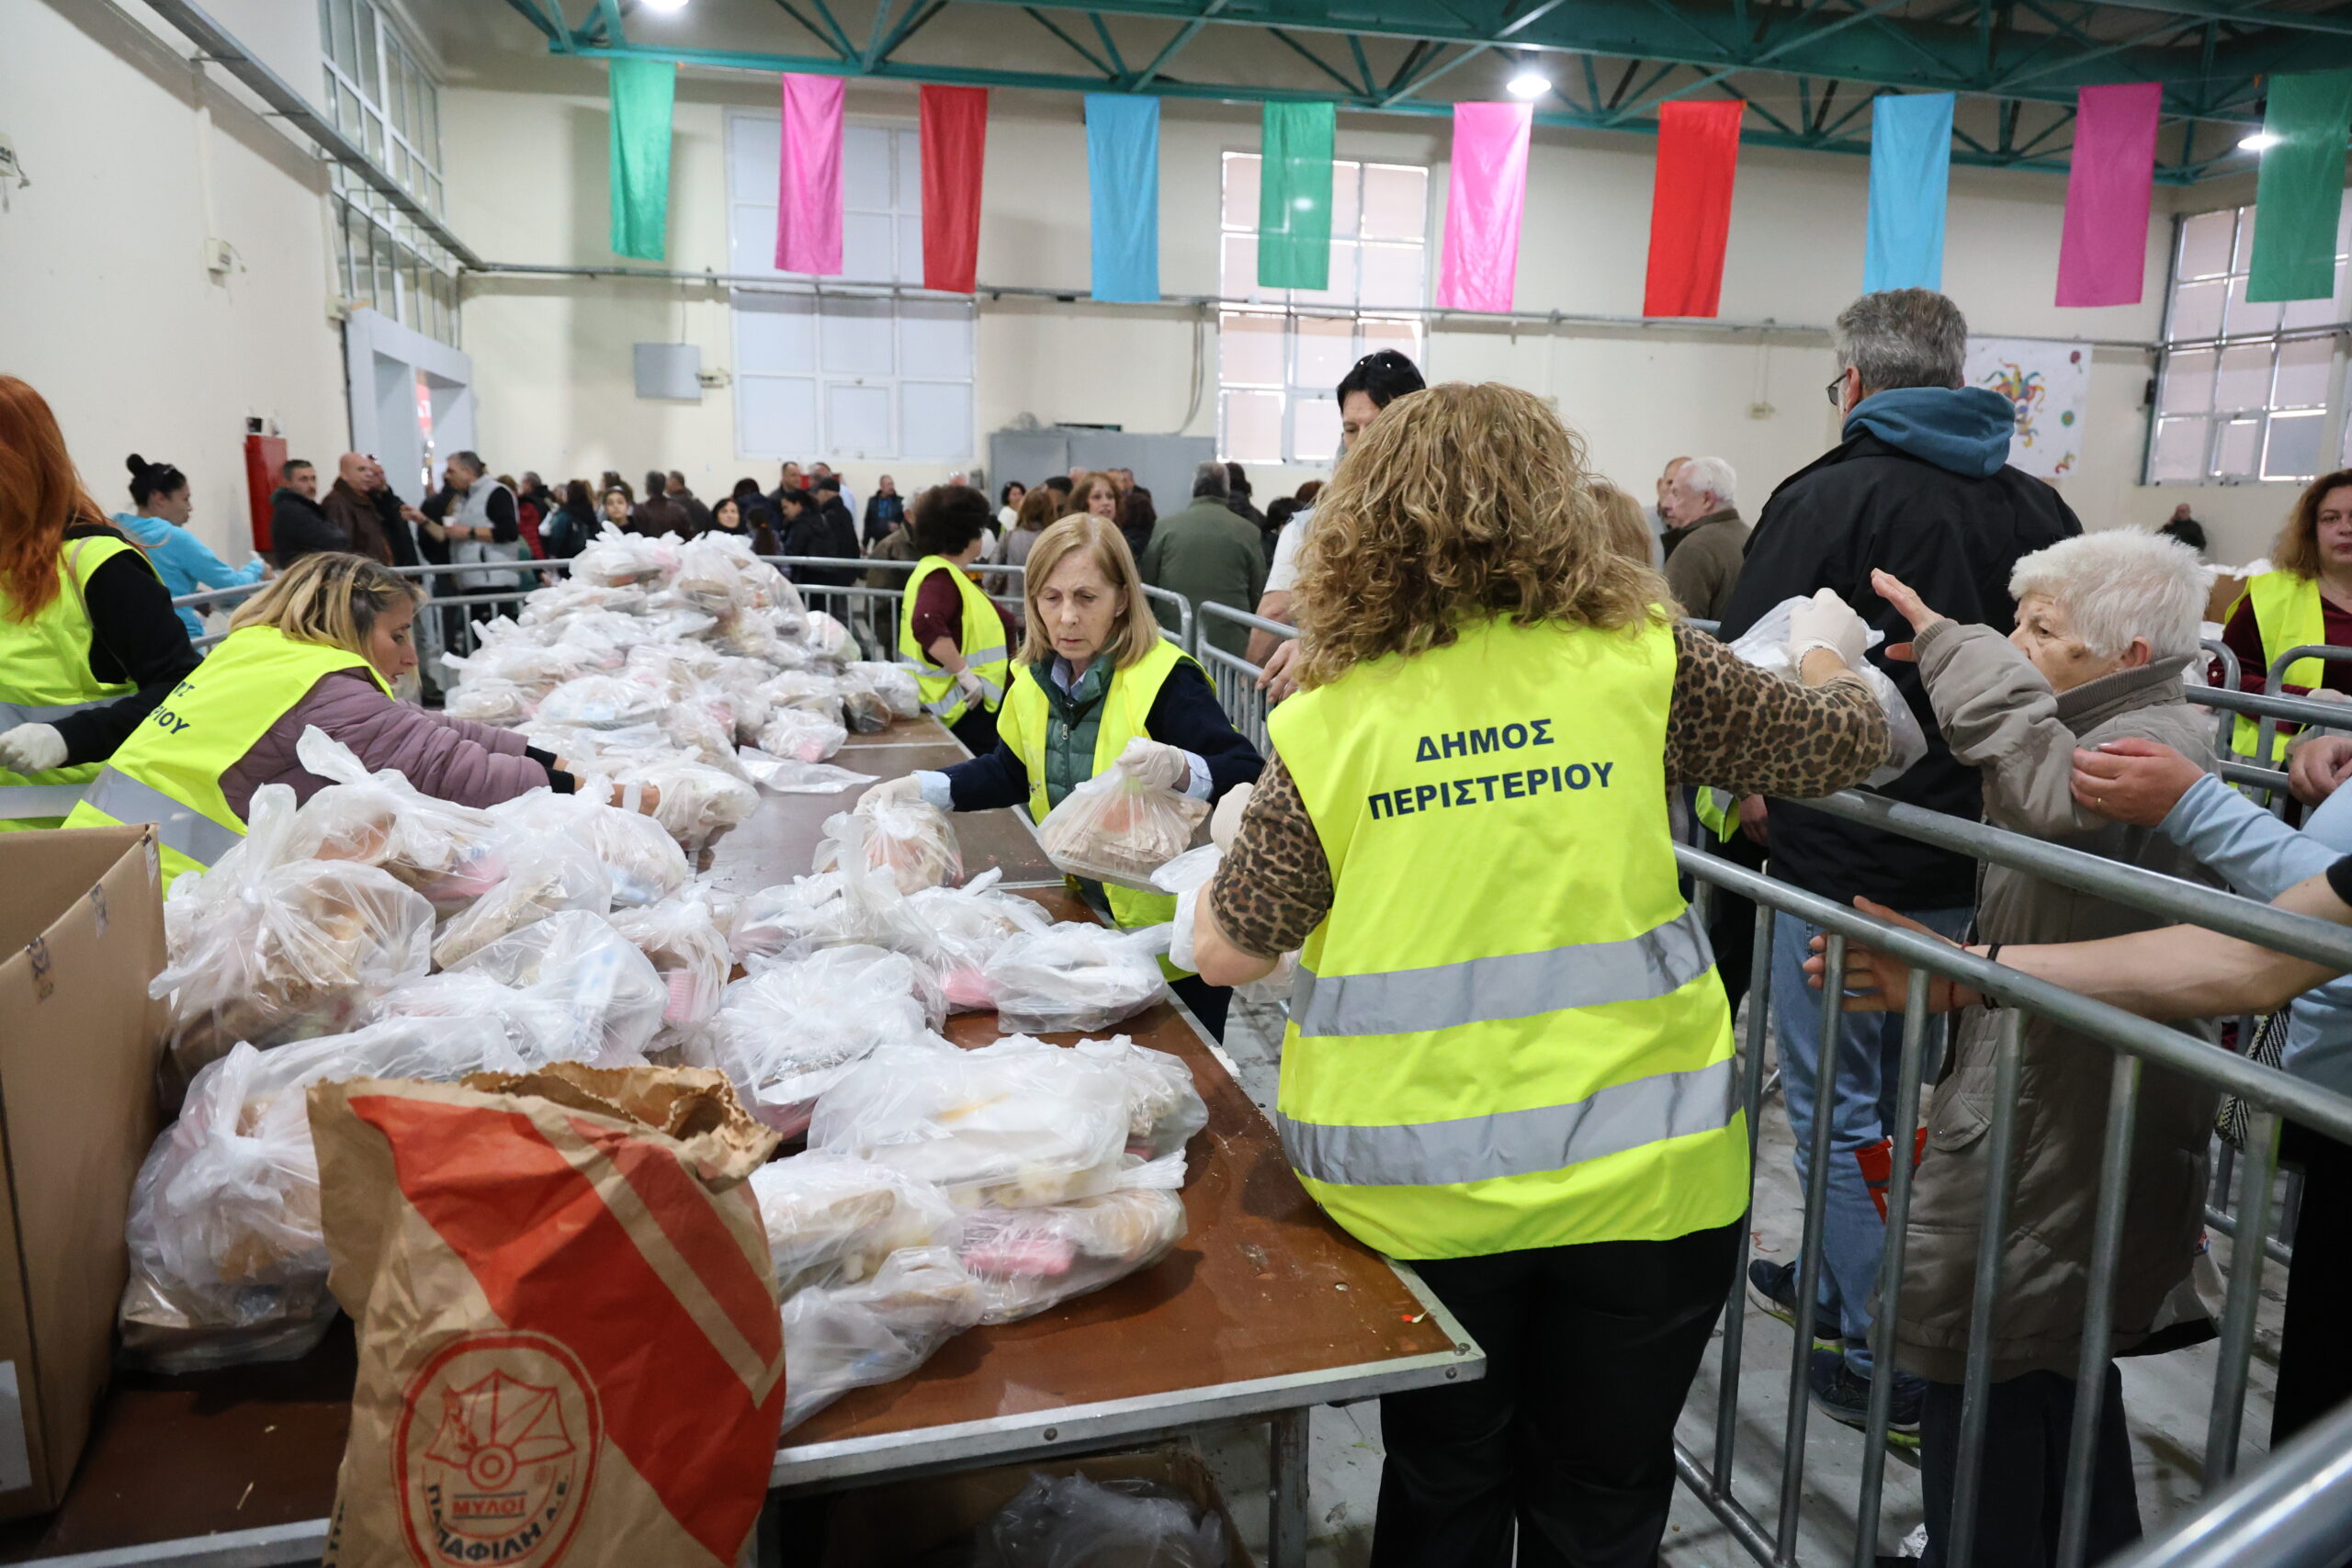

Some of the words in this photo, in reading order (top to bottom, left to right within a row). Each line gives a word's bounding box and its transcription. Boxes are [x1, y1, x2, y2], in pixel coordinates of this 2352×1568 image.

[1415, 717, 1555, 762] ΔΗΜΟΣ
[1368, 761, 1613, 820] ΠΕΡΙΣΤΕΡΙΟΥ
[452, 1496, 526, 1517] ΜΥΛΟΙ
